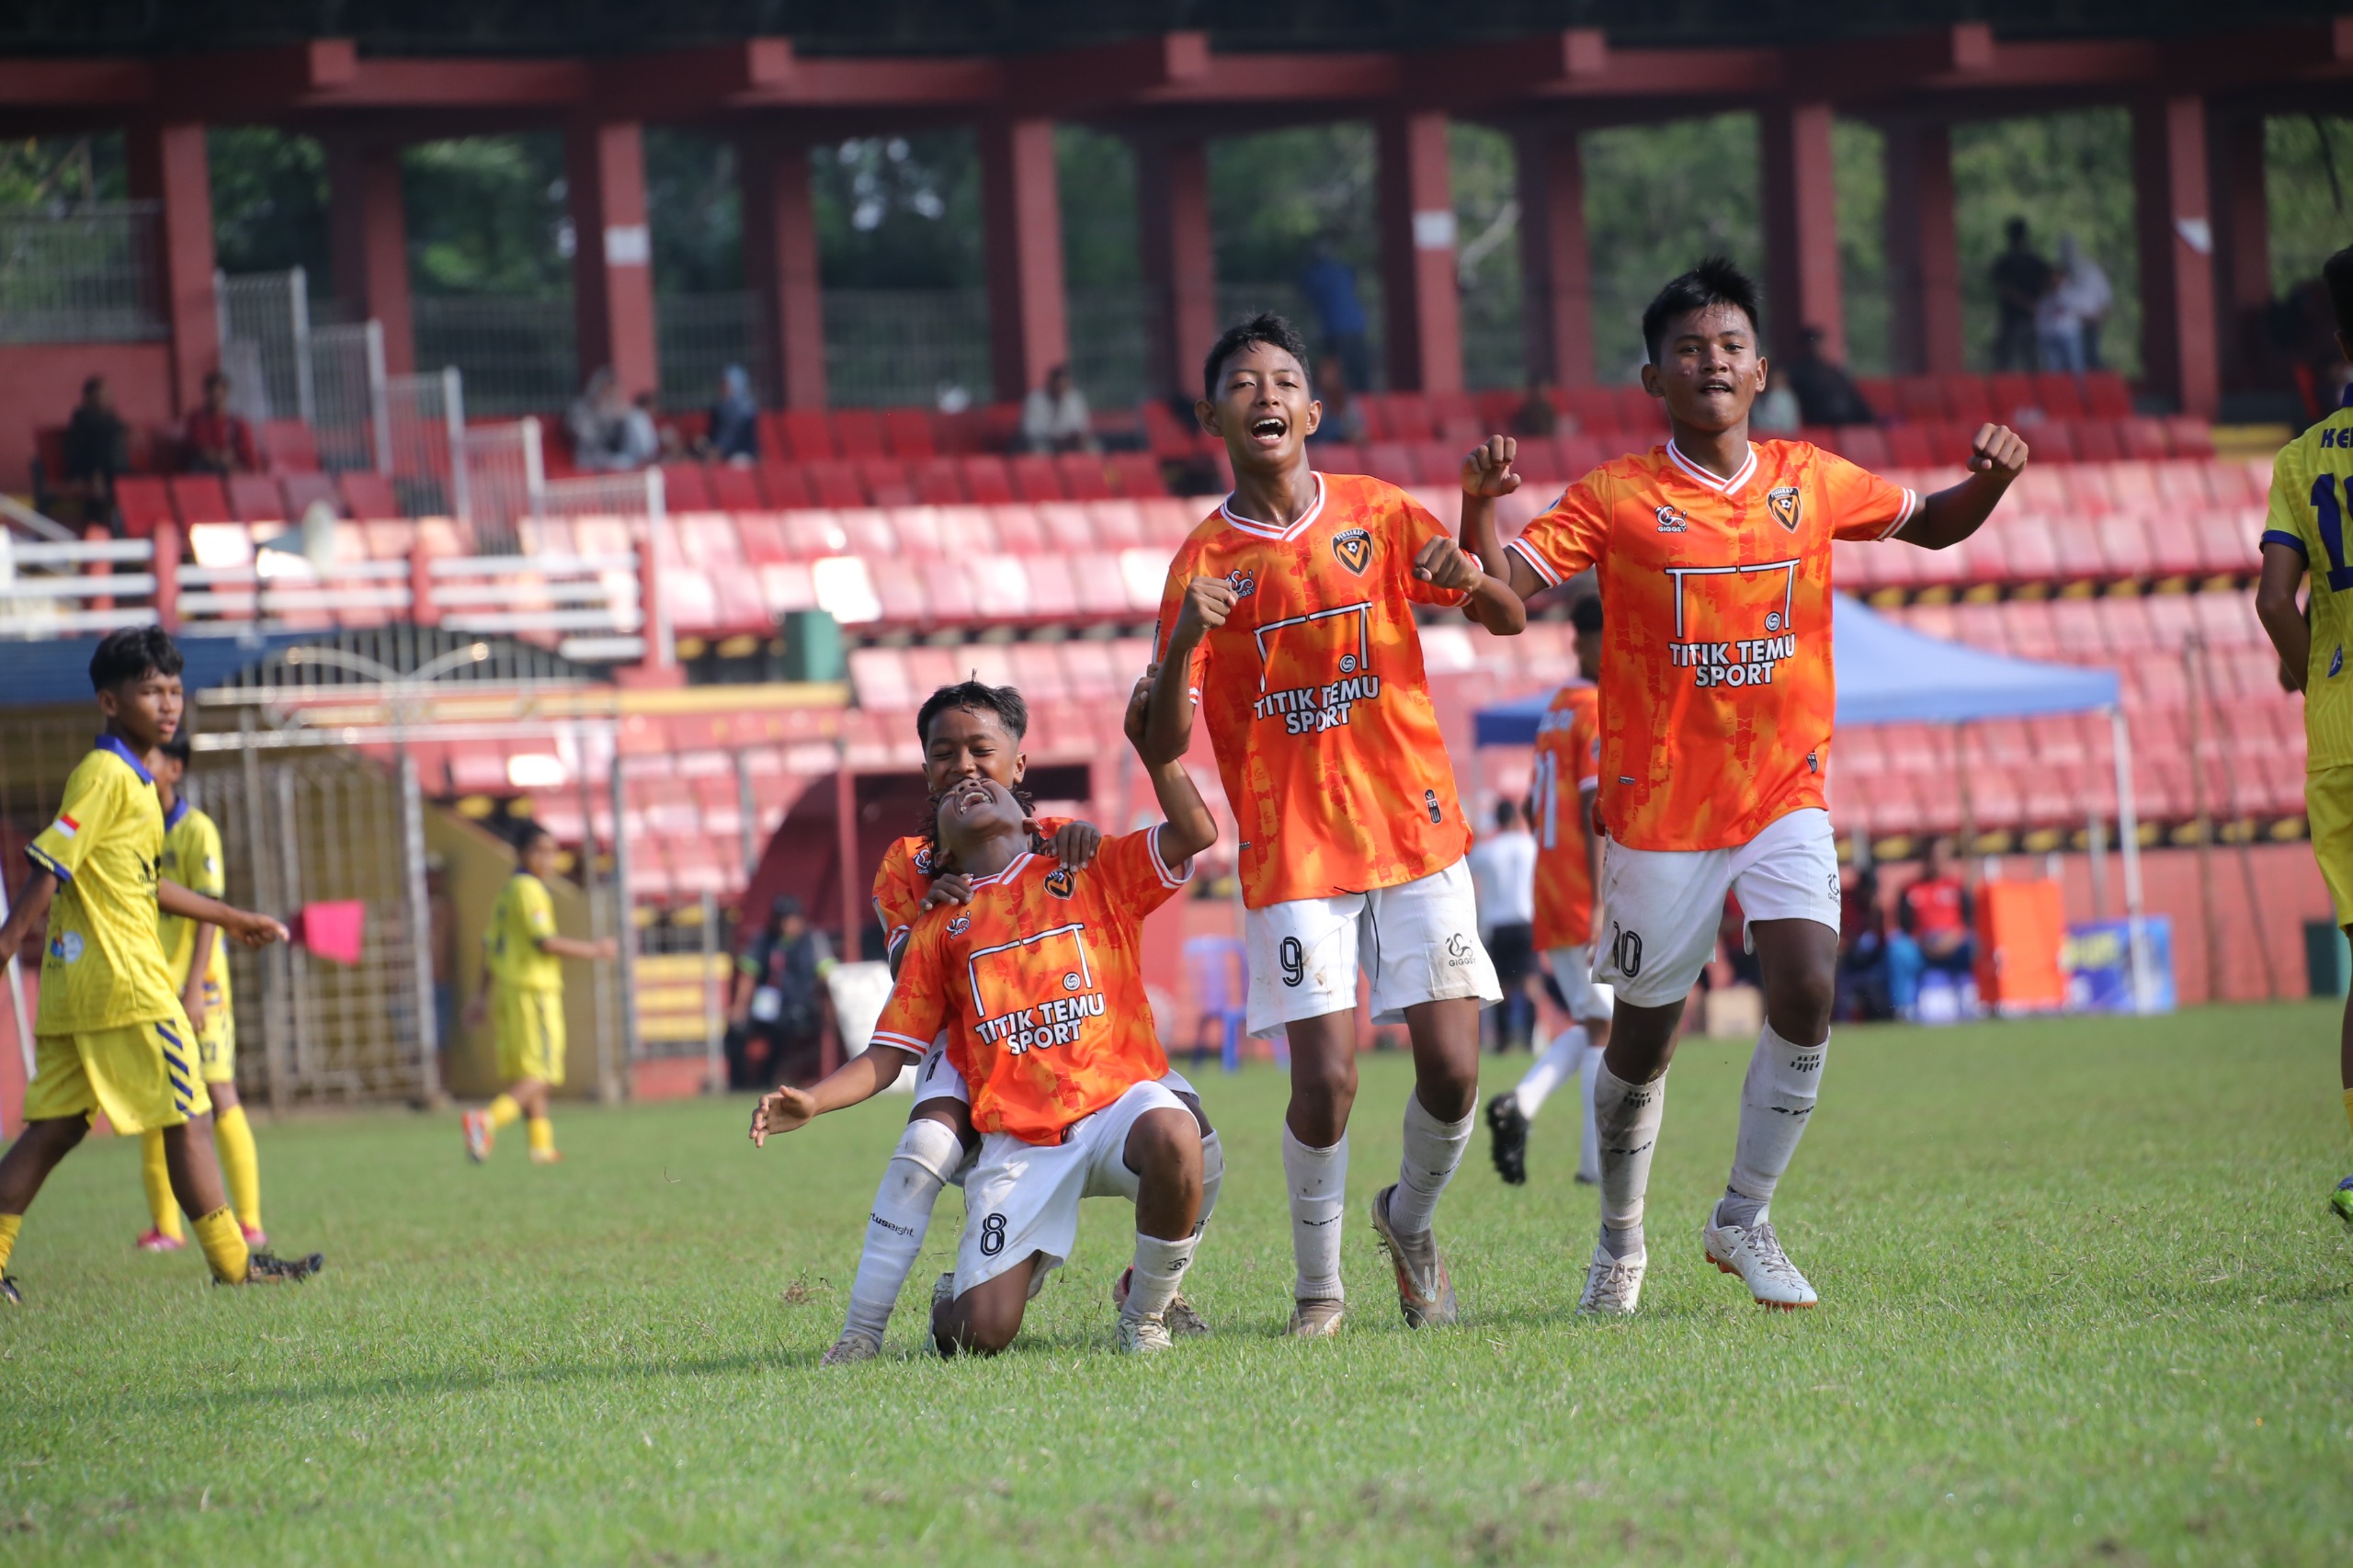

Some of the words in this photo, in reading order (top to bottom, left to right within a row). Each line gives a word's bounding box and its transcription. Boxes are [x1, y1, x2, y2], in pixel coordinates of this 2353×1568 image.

[2310, 472, 2353, 593] 1
[1668, 642, 1731, 667] TITIK
[1735, 632, 1796, 664] TEMU
[1695, 661, 1775, 687] SPORT
[1253, 687, 1317, 721] TITIK
[1320, 675, 1380, 709] TEMU
[1285, 701, 1352, 734] SPORT
[1279, 936, 1303, 988] 9
[1449, 957, 1476, 967] GIGGSY
[1613, 920, 1643, 978] 10
[974, 1007, 1035, 1045] TITIK
[1039, 993, 1106, 1025] TEMU
[1006, 1017, 1083, 1055] SPORT
[868, 1212, 915, 1238] rtuseight
[980, 1212, 1007, 1256] 8
